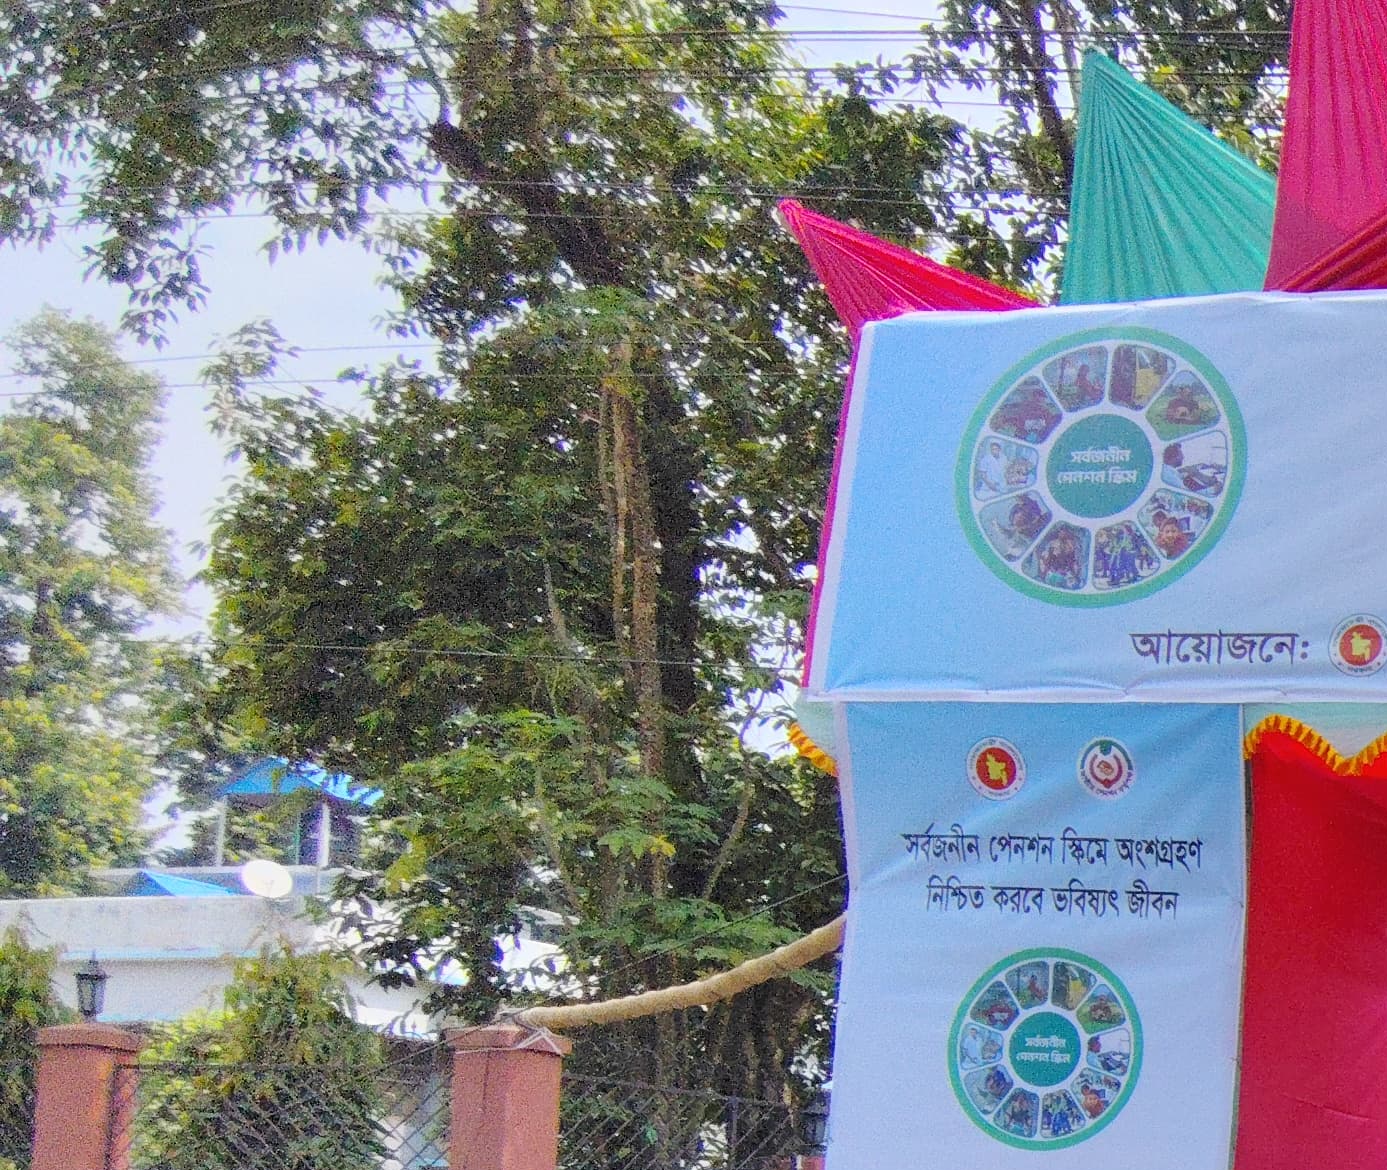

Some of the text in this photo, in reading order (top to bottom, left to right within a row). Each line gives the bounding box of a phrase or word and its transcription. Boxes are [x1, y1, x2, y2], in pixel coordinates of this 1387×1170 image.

[900, 822, 1203, 873] সর্বজনীন পেনশন স্কিমে অংশগ্রহণ
[926, 874, 1180, 919] নিশ্চিত করবে ভবিষ্যৎ জীবন
